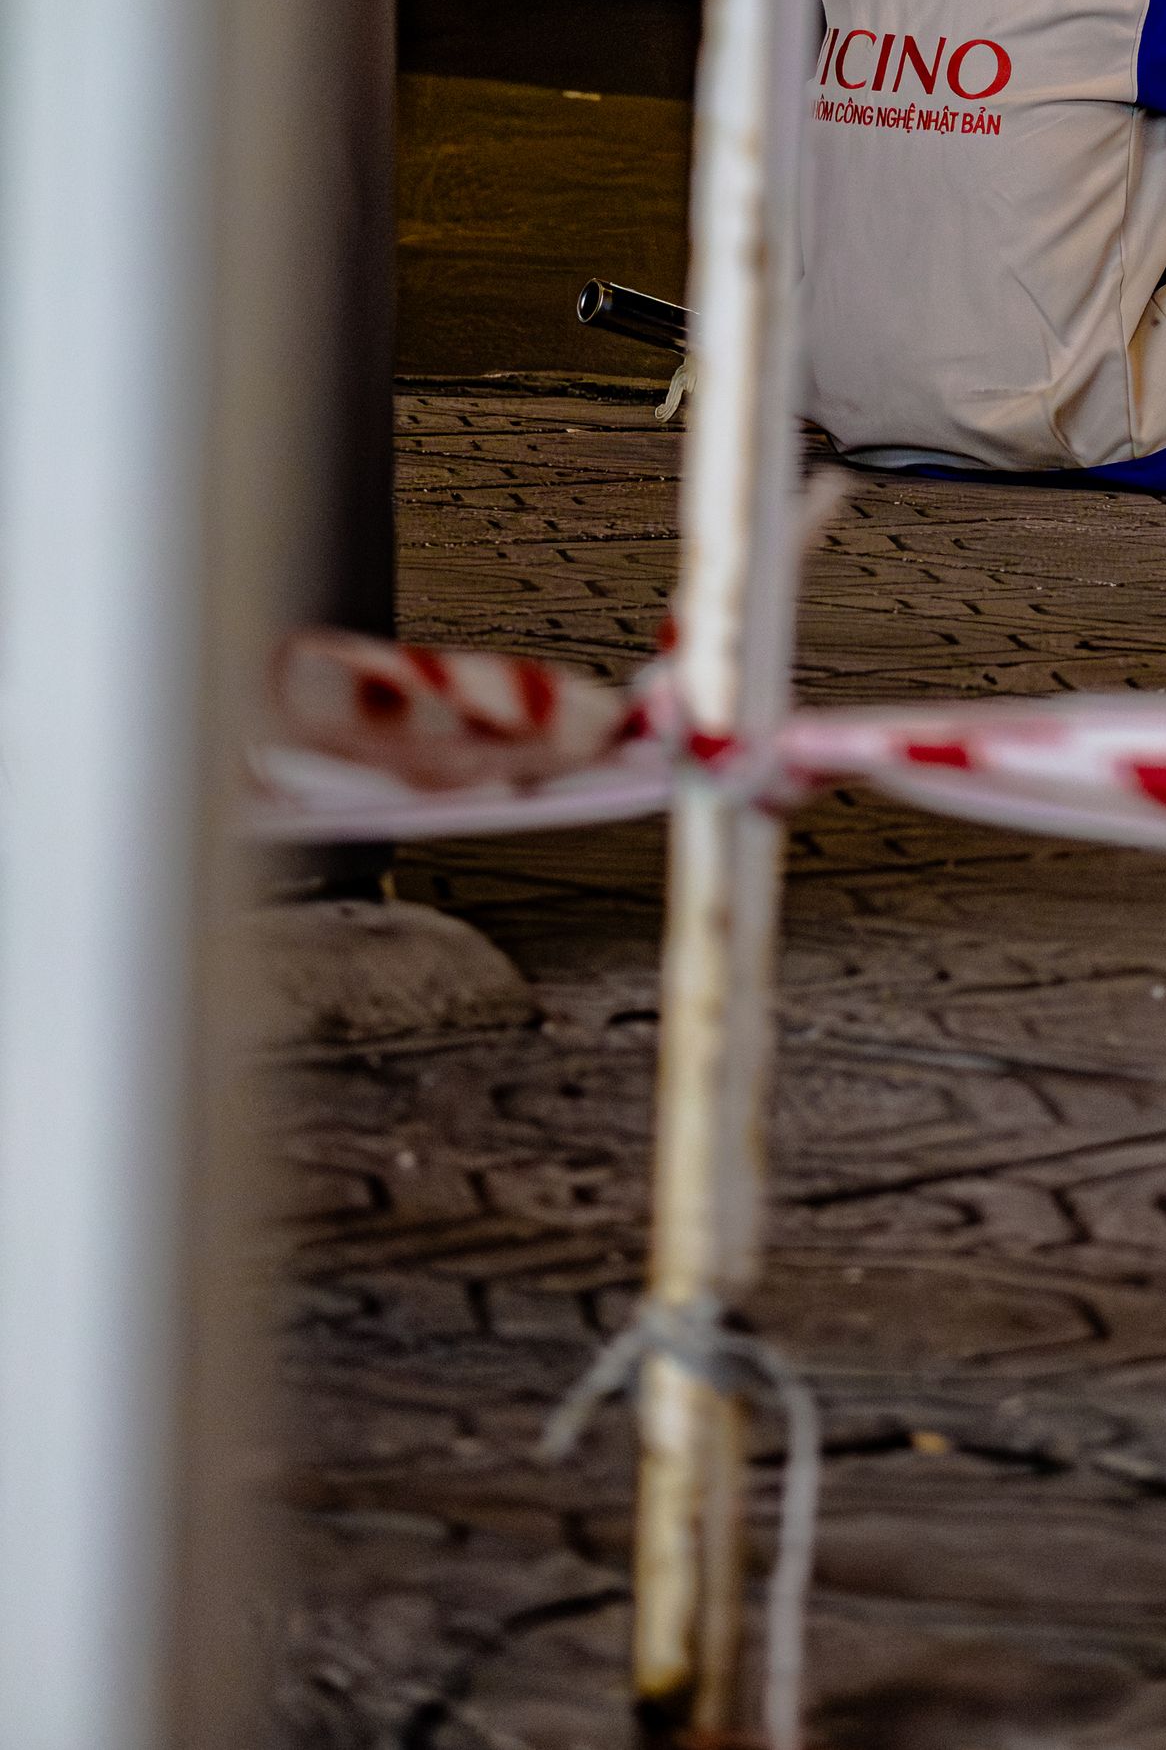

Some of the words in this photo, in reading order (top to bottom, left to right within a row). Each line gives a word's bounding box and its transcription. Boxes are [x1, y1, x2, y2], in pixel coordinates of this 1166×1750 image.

[835, 96, 874, 126] CÔNG
[875, 102, 916, 134] NGHỆ
[916, 105, 960, 135] NHẬT
[960, 106, 1002, 136] BẢN
